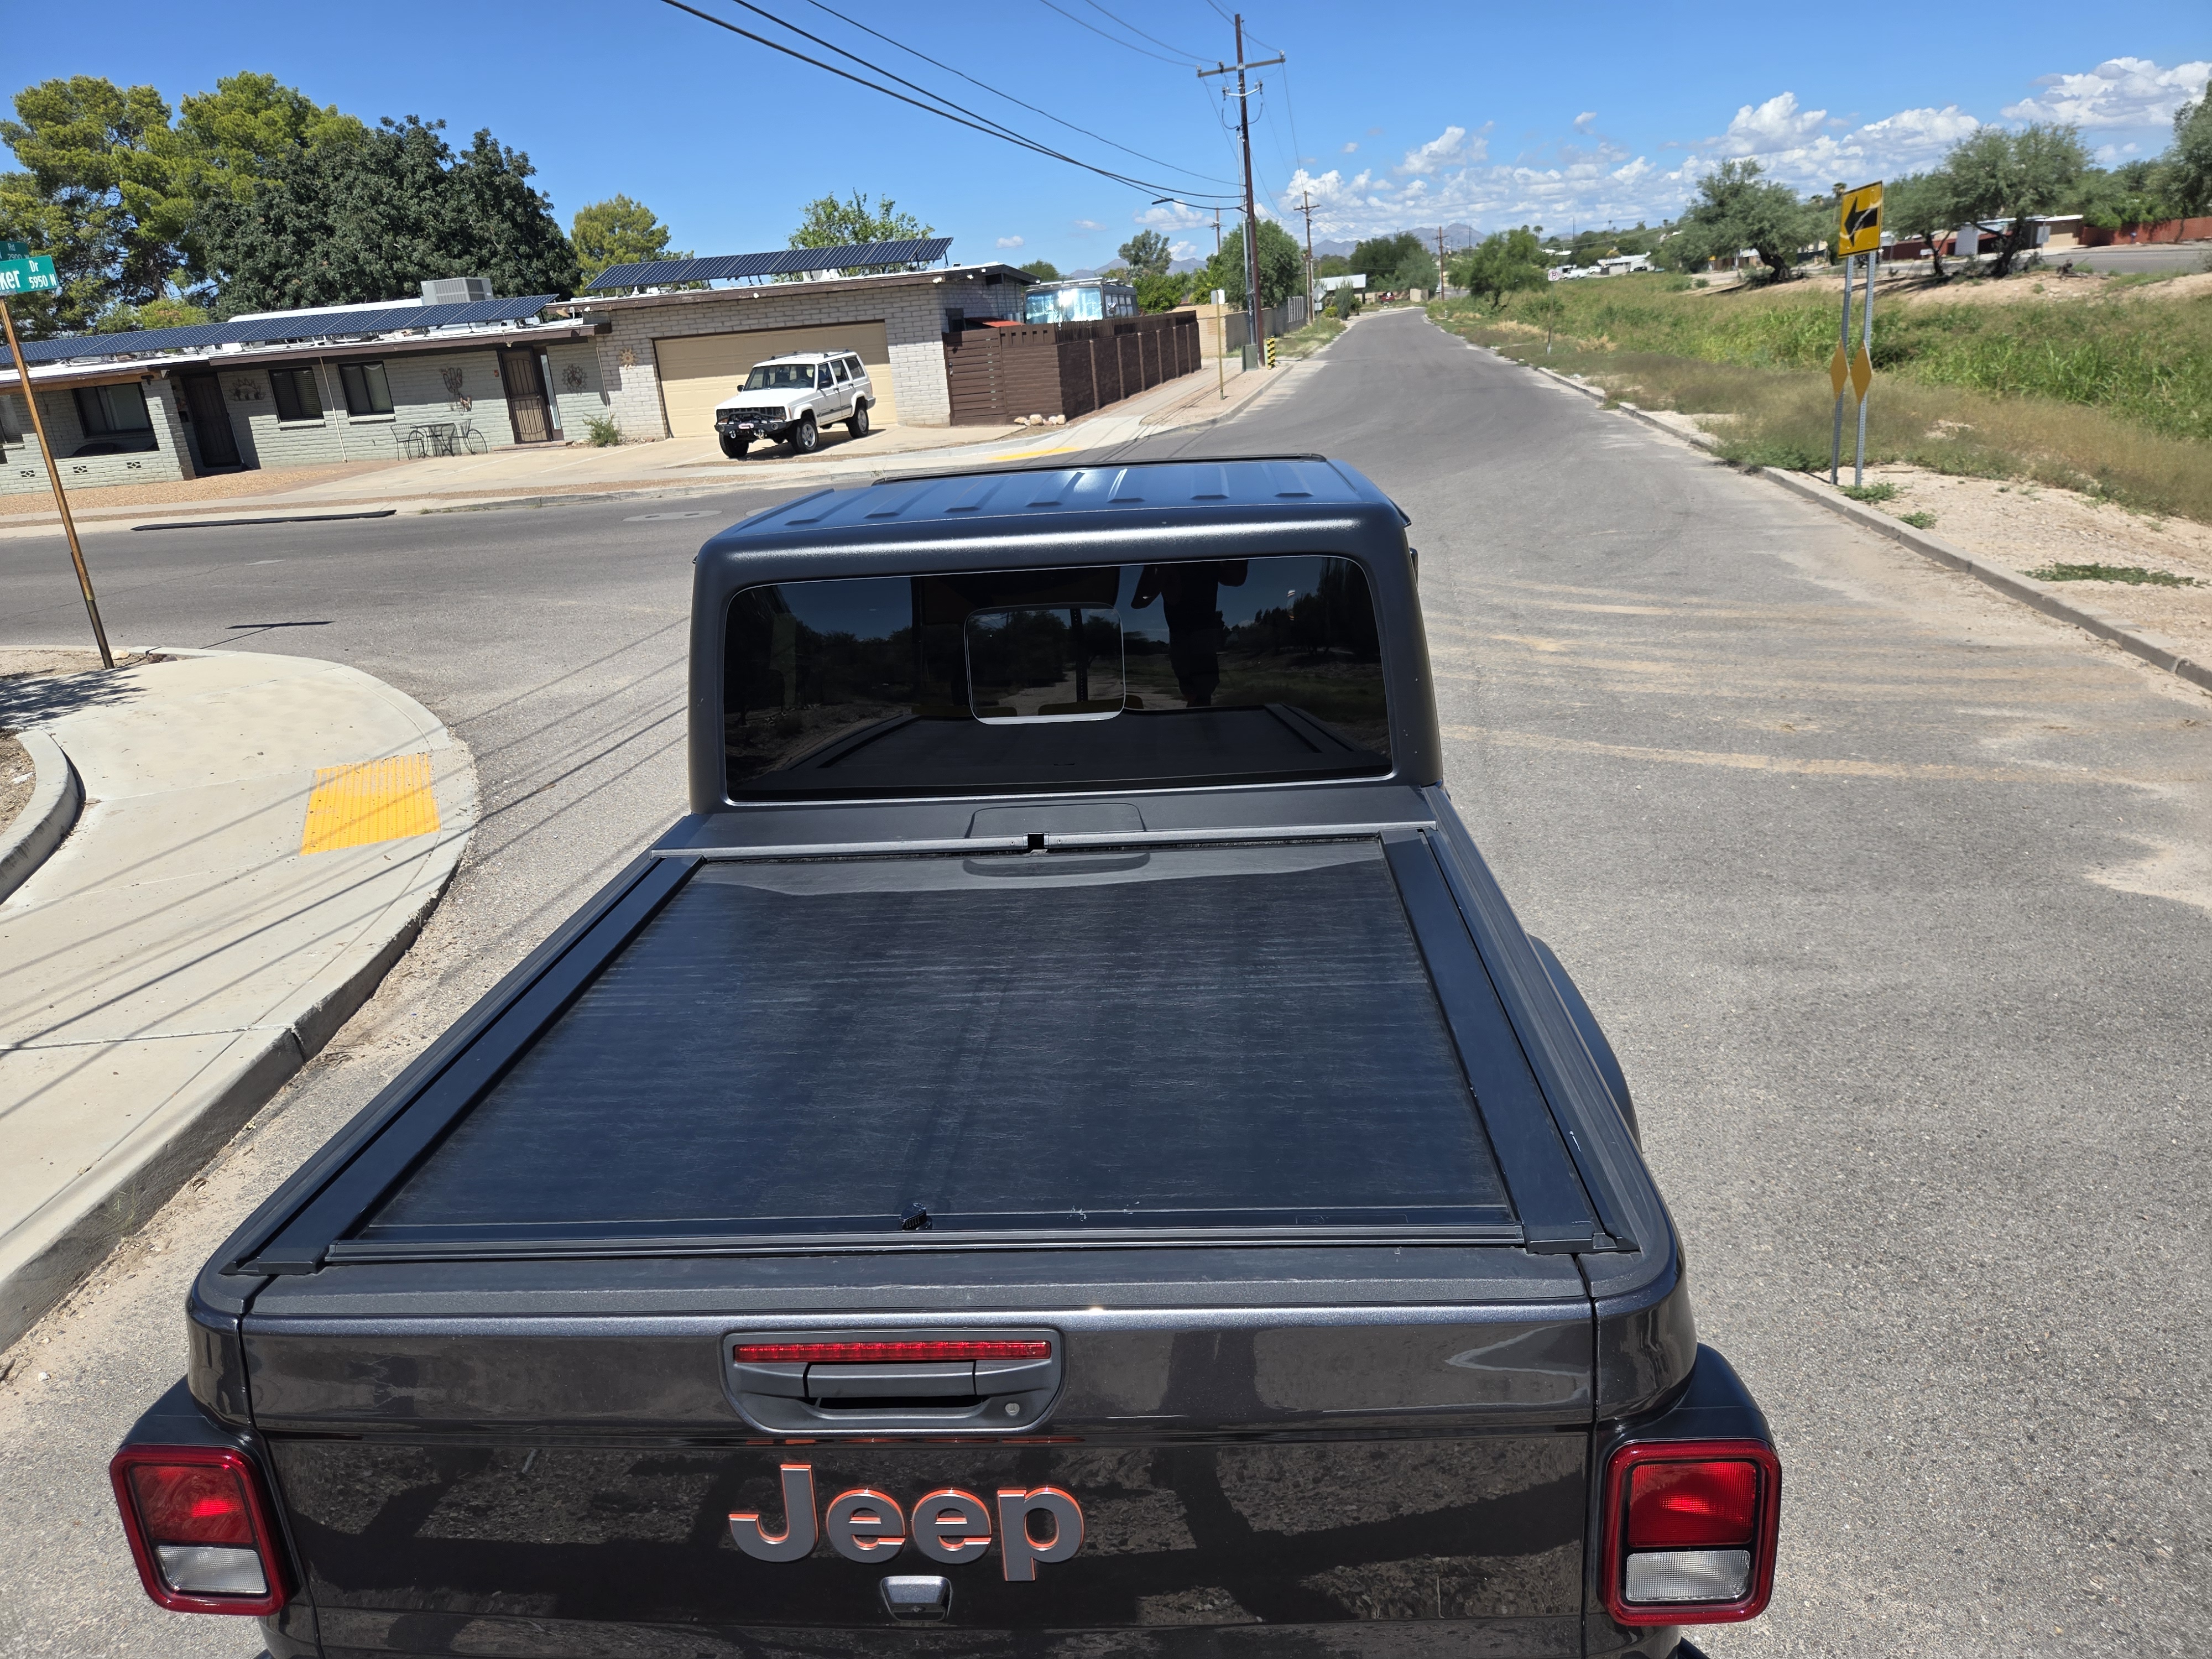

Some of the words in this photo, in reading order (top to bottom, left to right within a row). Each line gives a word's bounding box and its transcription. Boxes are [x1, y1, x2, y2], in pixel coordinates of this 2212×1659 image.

[29, 260, 39, 272] Dr
[0, 270, 21, 290] ker
[28, 275, 49, 289] 5950
[49, 274, 57, 286] N
[729, 1464, 1085, 1582] Jeep
